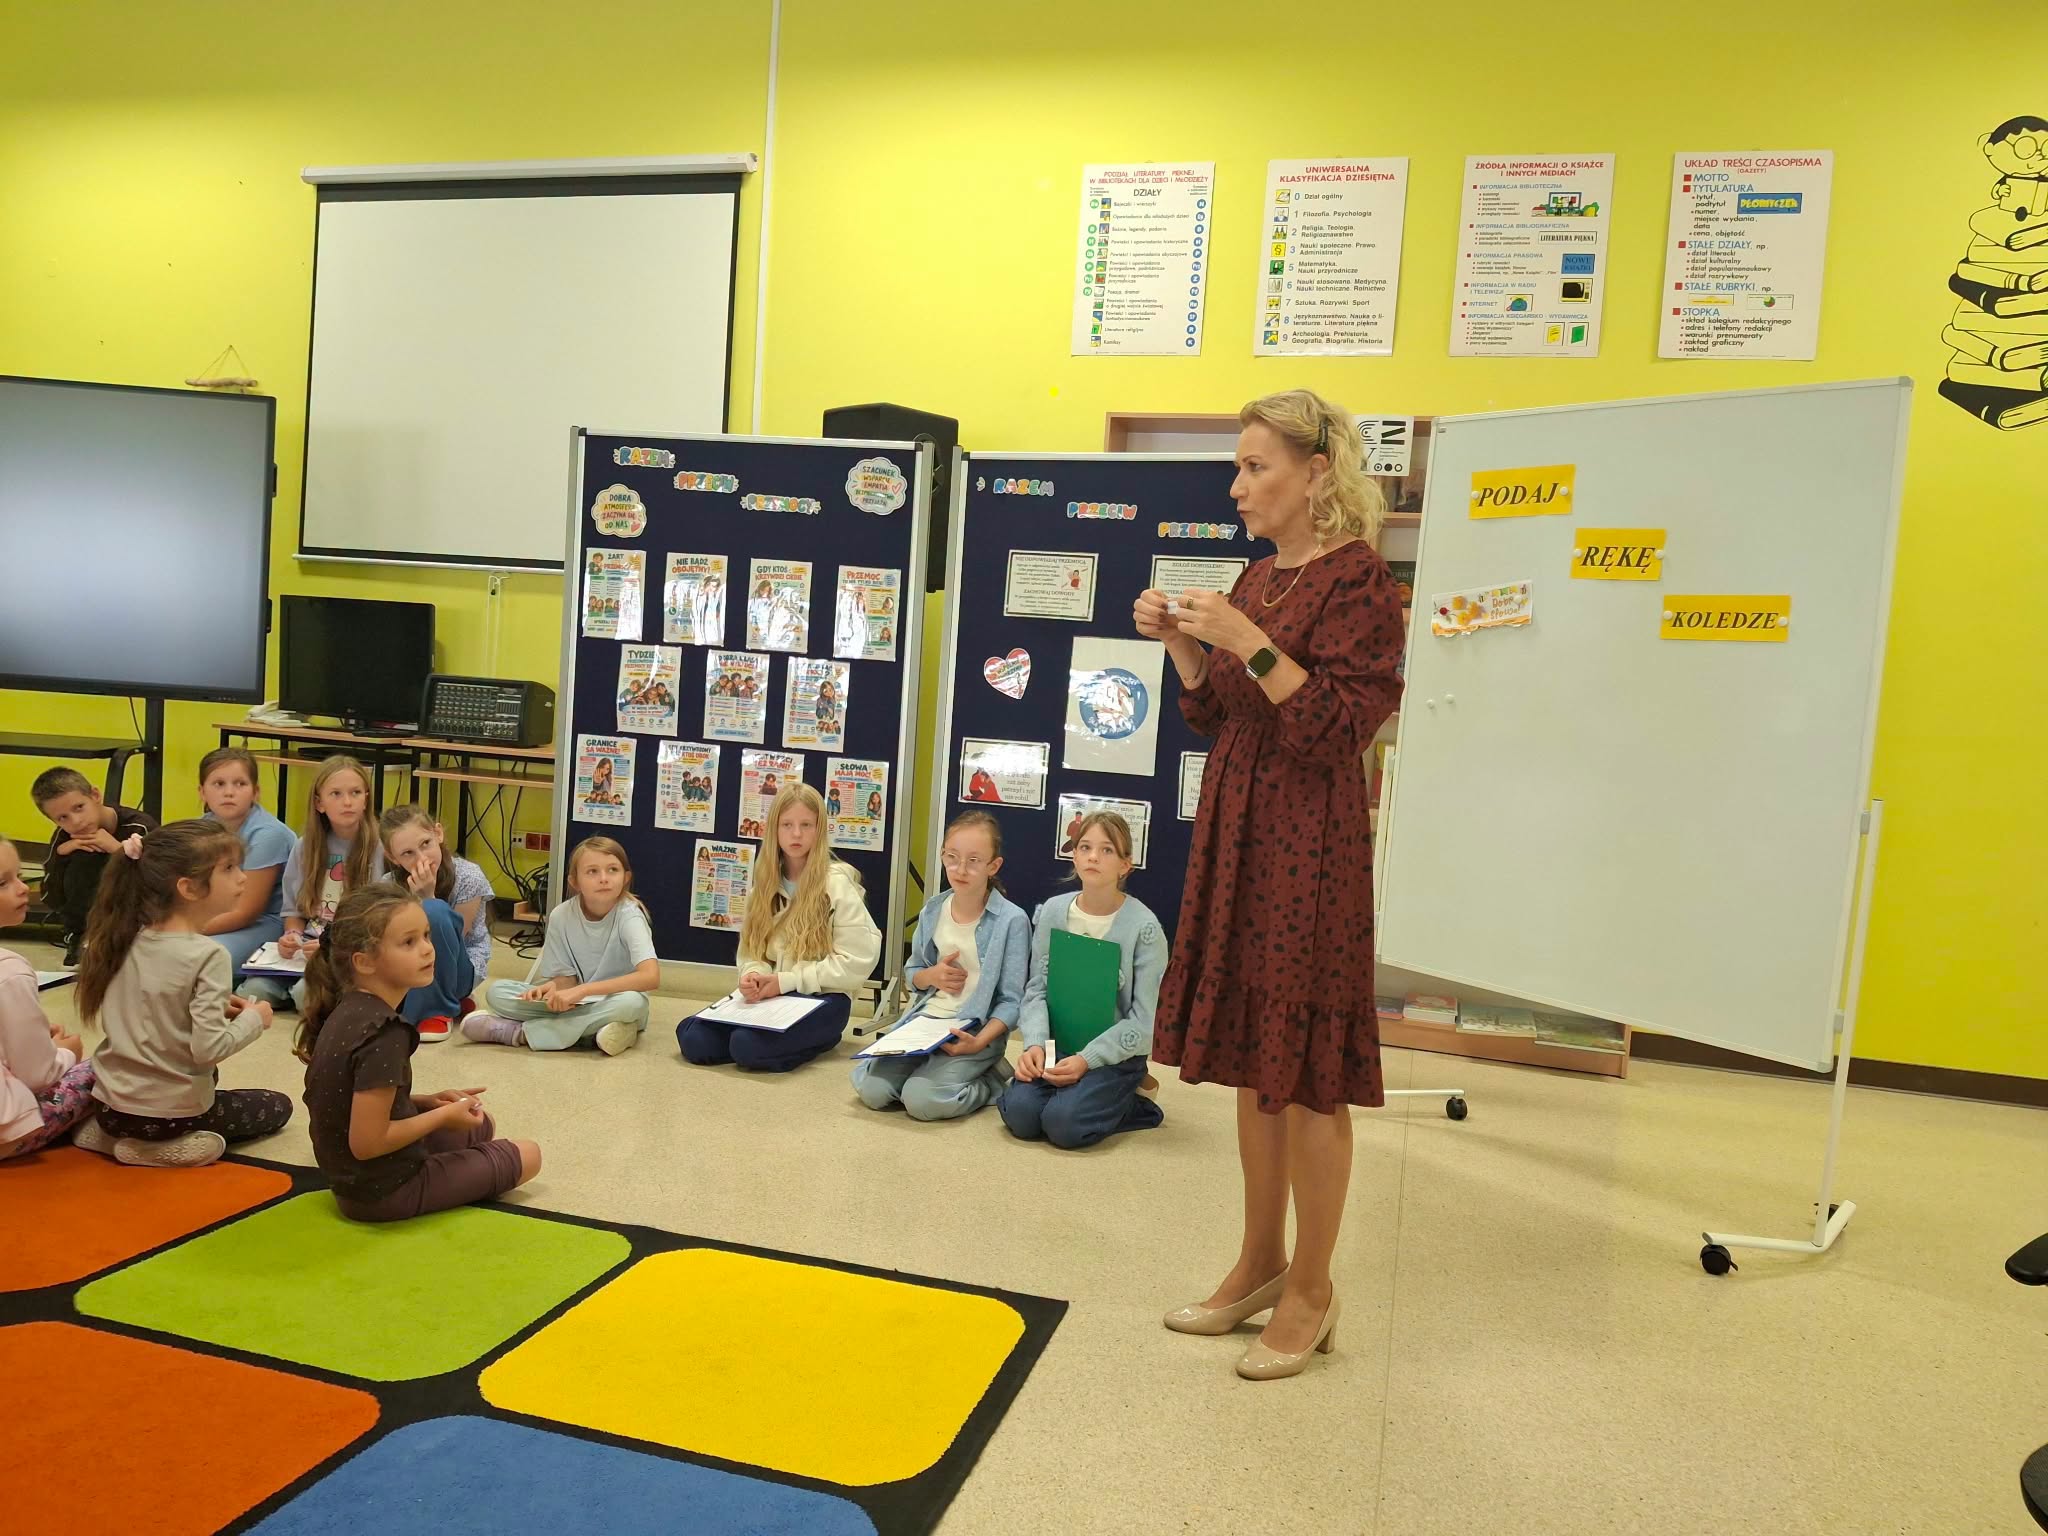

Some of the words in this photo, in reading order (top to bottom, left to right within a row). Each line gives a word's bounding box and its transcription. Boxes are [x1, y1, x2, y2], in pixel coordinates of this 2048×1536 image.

[1571, 161, 1604, 169] KSIĄŻCE
[1685, 160, 1718, 168] UKŁAD
[1723, 158, 1752, 167] TREŚCI
[1756, 158, 1821, 166] CZASOPISMA
[1346, 174, 1395, 182] DZIESIĘTNA
[1693, 174, 1729, 182] MOTTO
[1718, 241, 1752, 249] DZIAŁY,
[1565, 256, 1591, 264] NOWE
[1716, 283, 1757, 292] RUBRYKI,
[1683, 308, 1720, 316] STOPKA
[1717, 332, 1763, 340] prenumeraty
[620, 448, 670, 467] RAZEM
[862, 466, 895, 477] SZACUNEK
[863, 482, 888, 490] EMPATIA
[993, 478, 1055, 496] RAZEM
[1477, 482, 1559, 508] PODAJ
[1067, 502, 1138, 520] PRZECIW
[1158, 522, 1238, 540] PRZEMOCY
[1581, 546, 1656, 574] RĘKĘ
[773, 565, 788, 573] KTOŚ
[847, 571, 880, 580] PRZEMOC
[1672, 611, 1779, 629] KOLEDZE
[628, 650, 662, 658] TYDZIE
[586, 739, 618, 747] GRANICE
[840, 763, 867, 771] SŁOWA
[712, 845, 737, 854] WAŻNE
